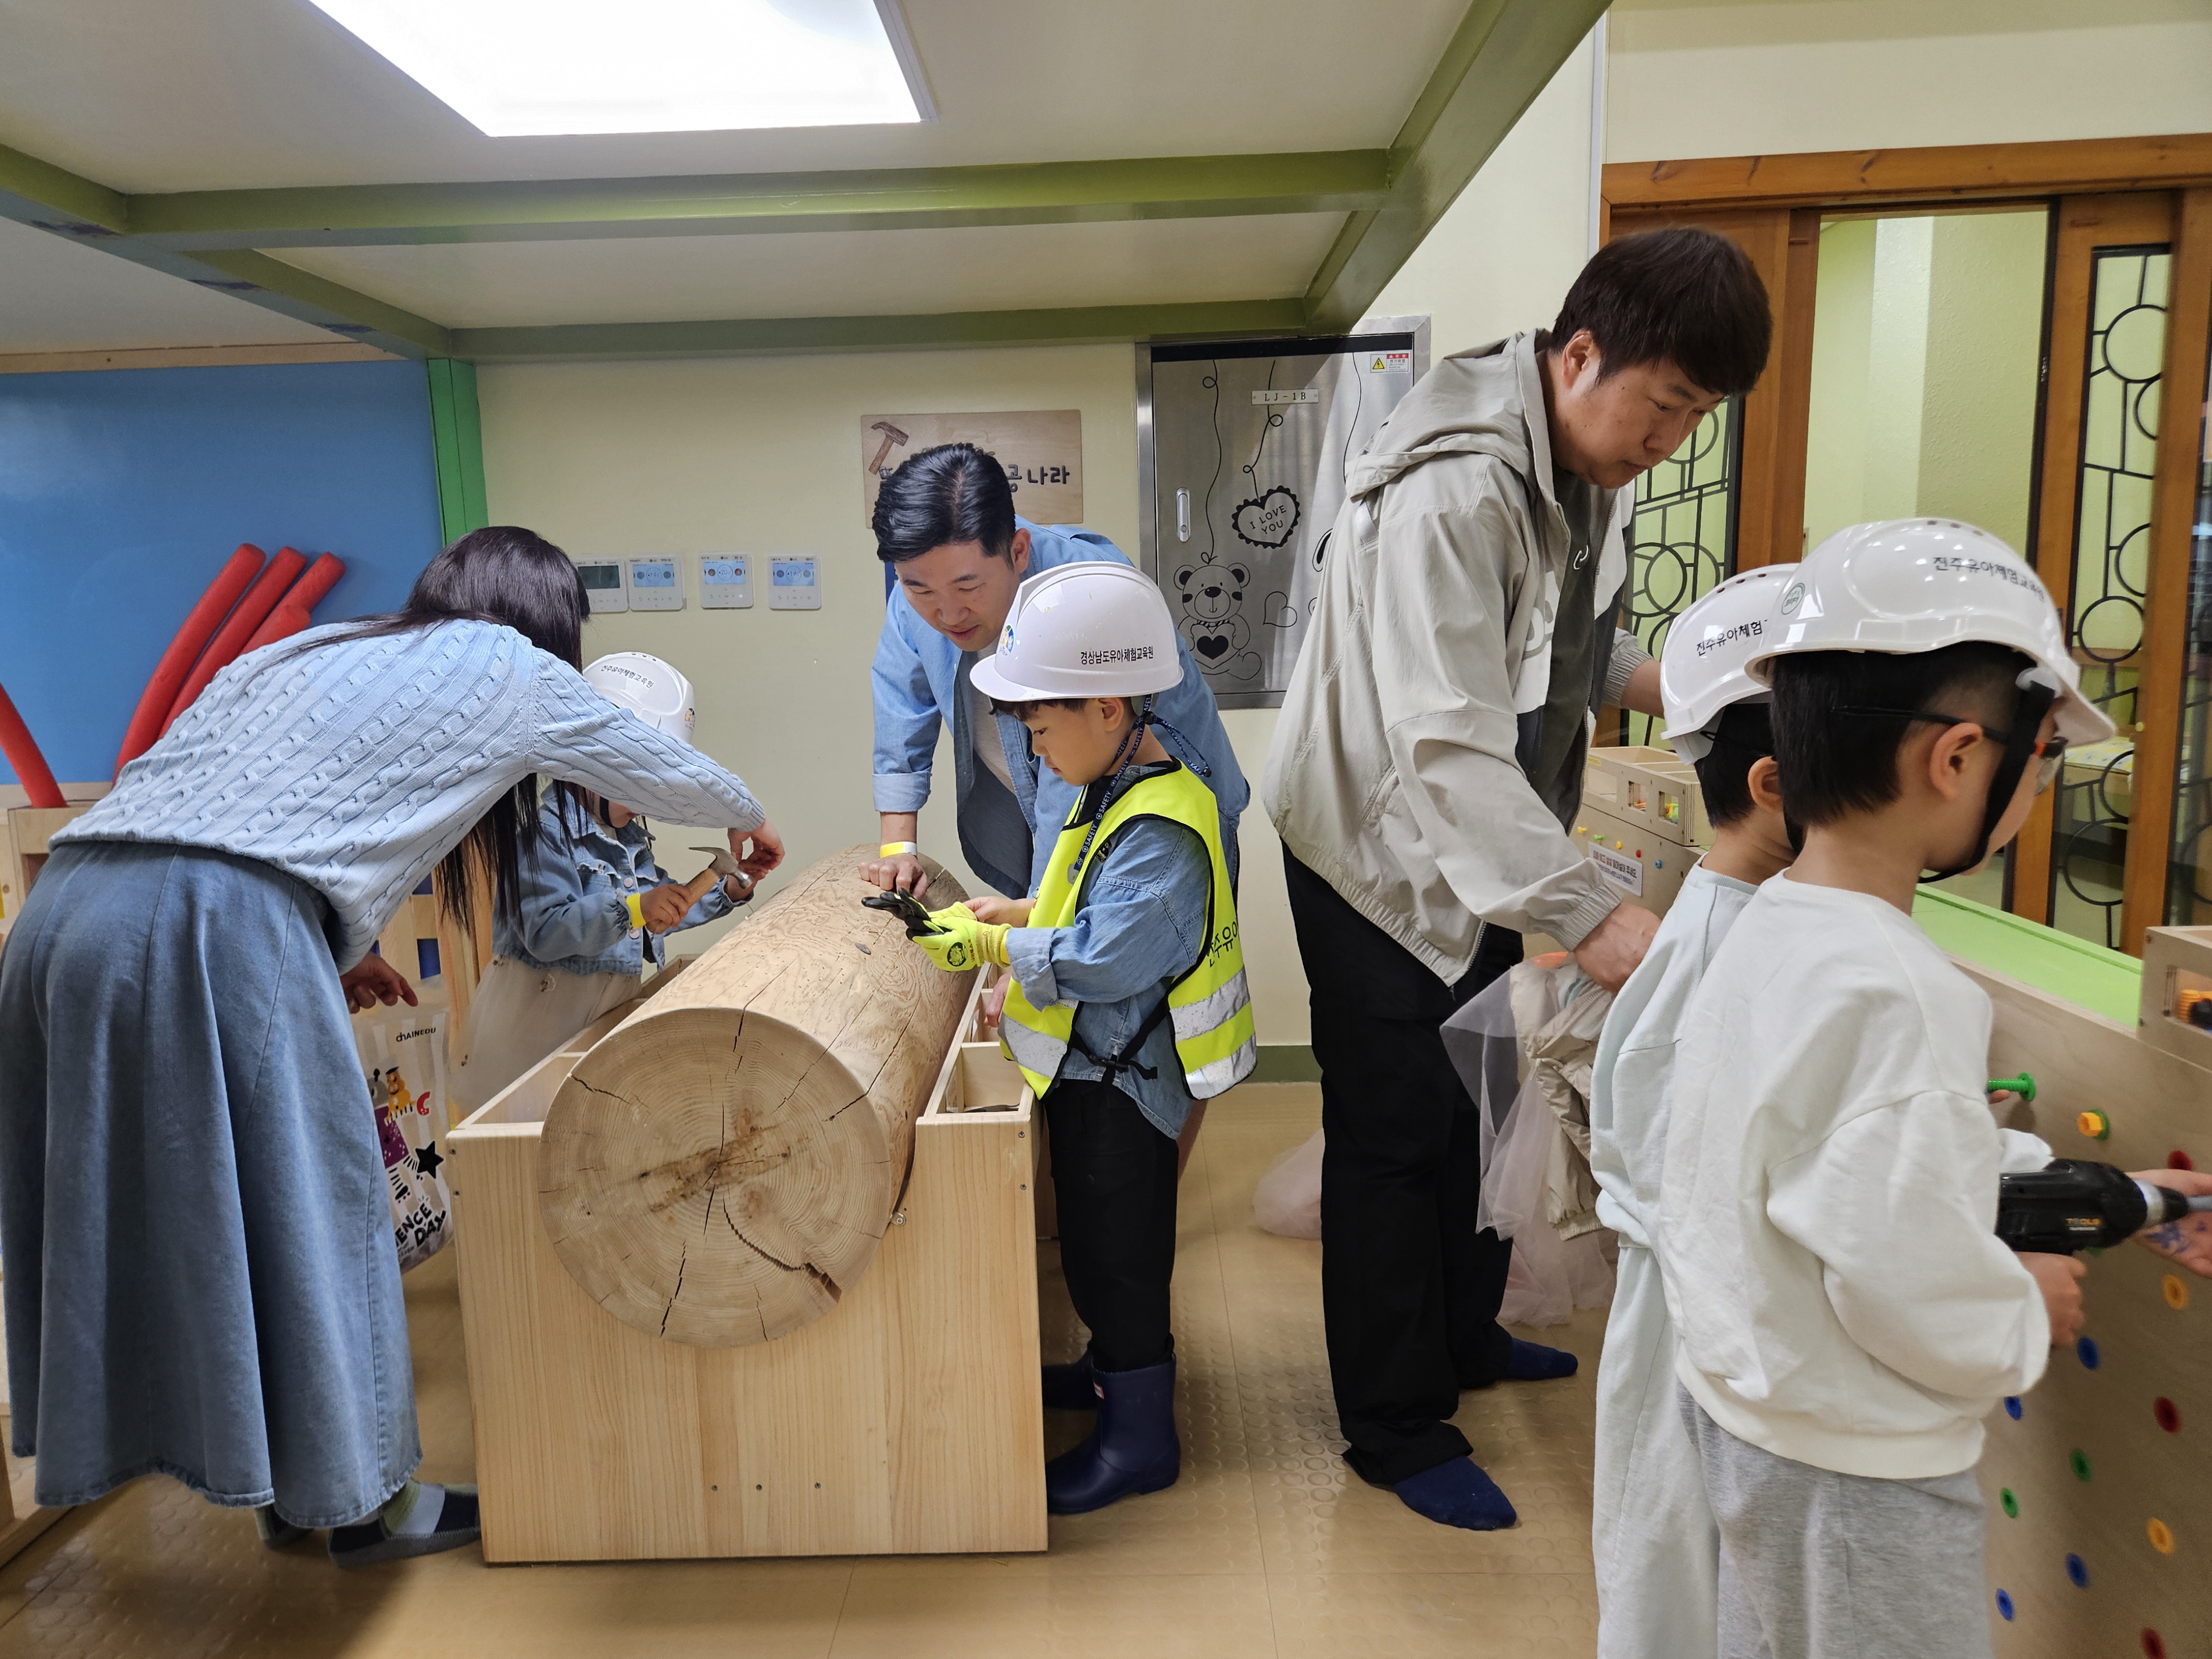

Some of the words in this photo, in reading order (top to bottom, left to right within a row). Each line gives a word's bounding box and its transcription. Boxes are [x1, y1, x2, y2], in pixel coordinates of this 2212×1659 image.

[1006, 464, 1070, 493] 공나라
[1250, 521, 1256, 530] I
[1259, 505, 1287, 524] LOVE
[1261, 520, 1283, 535] YOU
[1697, 619, 1768, 657] 진주유아체험
[1081, 646, 1153, 665] 경상남도유아체험교육원
[1114, 759, 1129, 780] SAFETY
[1098, 791, 1112, 814] SAFETY
[1085, 824, 1098, 846] SAFETY
[414, 1210, 446, 1247] DAY
